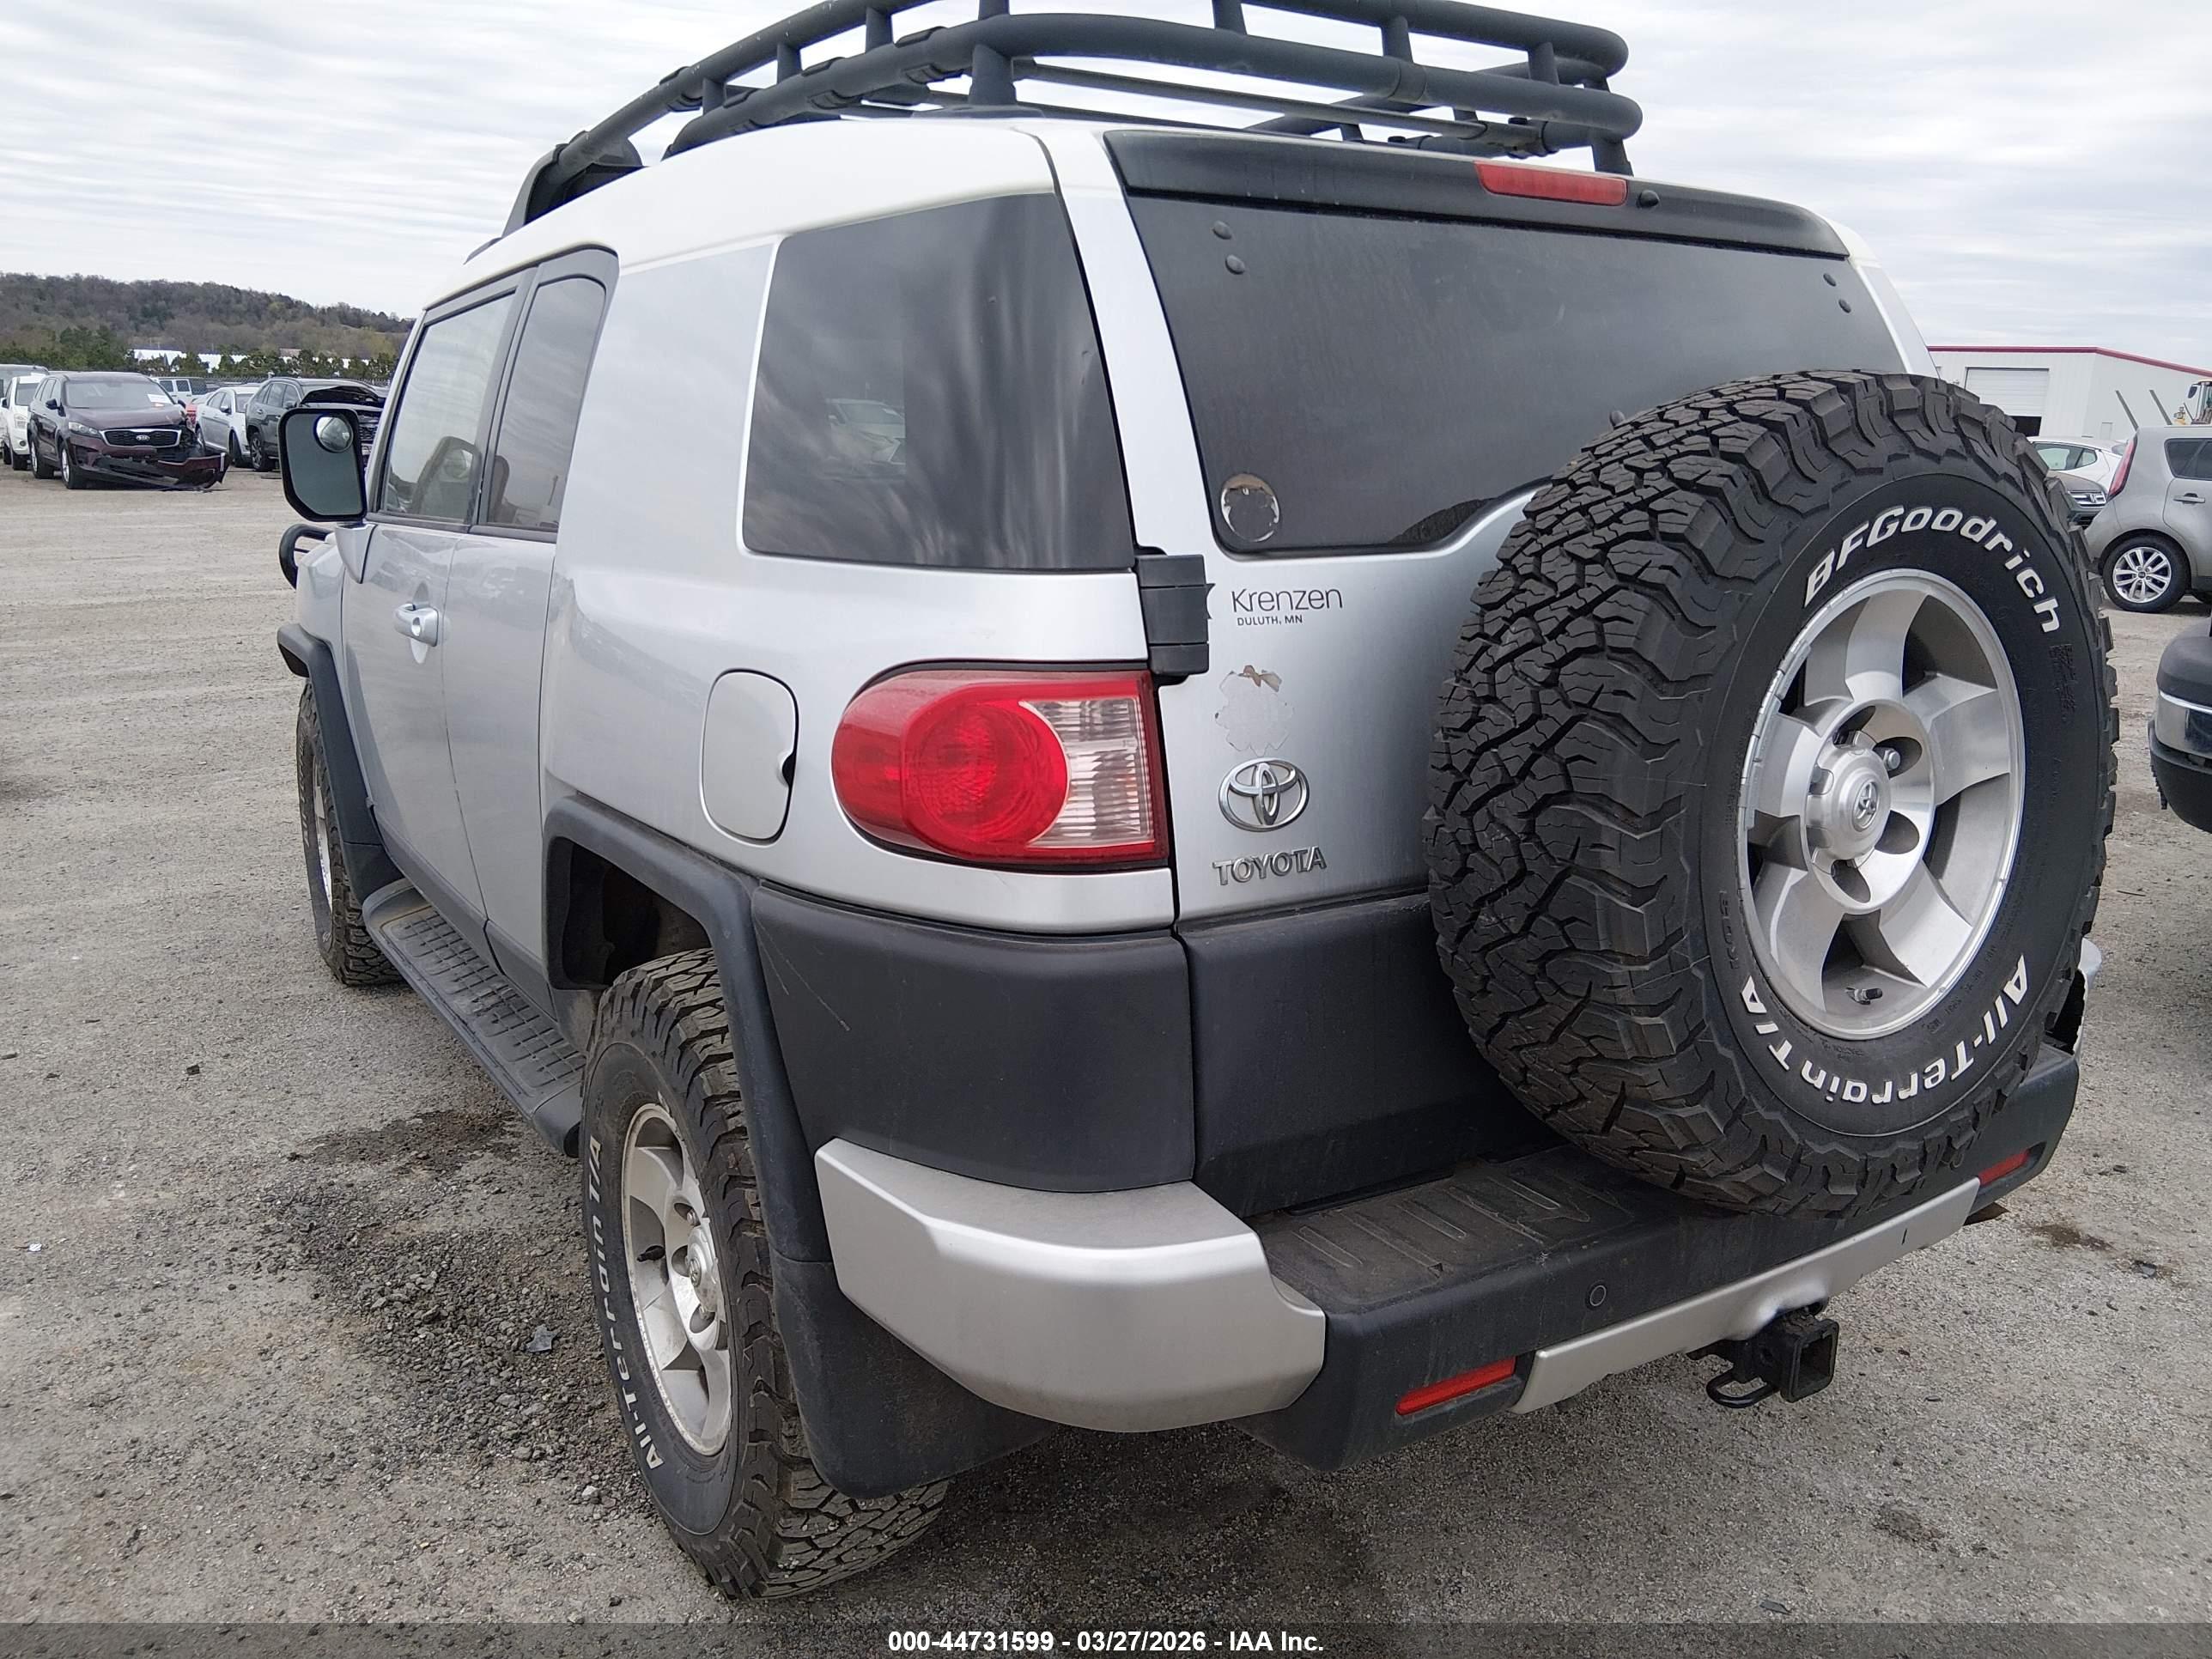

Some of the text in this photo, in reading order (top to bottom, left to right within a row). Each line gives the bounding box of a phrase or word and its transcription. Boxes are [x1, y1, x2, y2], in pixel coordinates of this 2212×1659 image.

[1231, 587, 1343, 612] Krenzen
[1804, 506, 2060, 633] BFGoodrich
[1238, 614, 1304, 626] DULUTH, MN
[1212, 846, 1327, 886] TOYOTA
[1741, 975, 1790, 1071] T/A
[1802, 955, 2028, 1104] All-Terrain
[588, 1134, 603, 1202] T/A
[592, 1215, 665, 1470] All-Terrain
